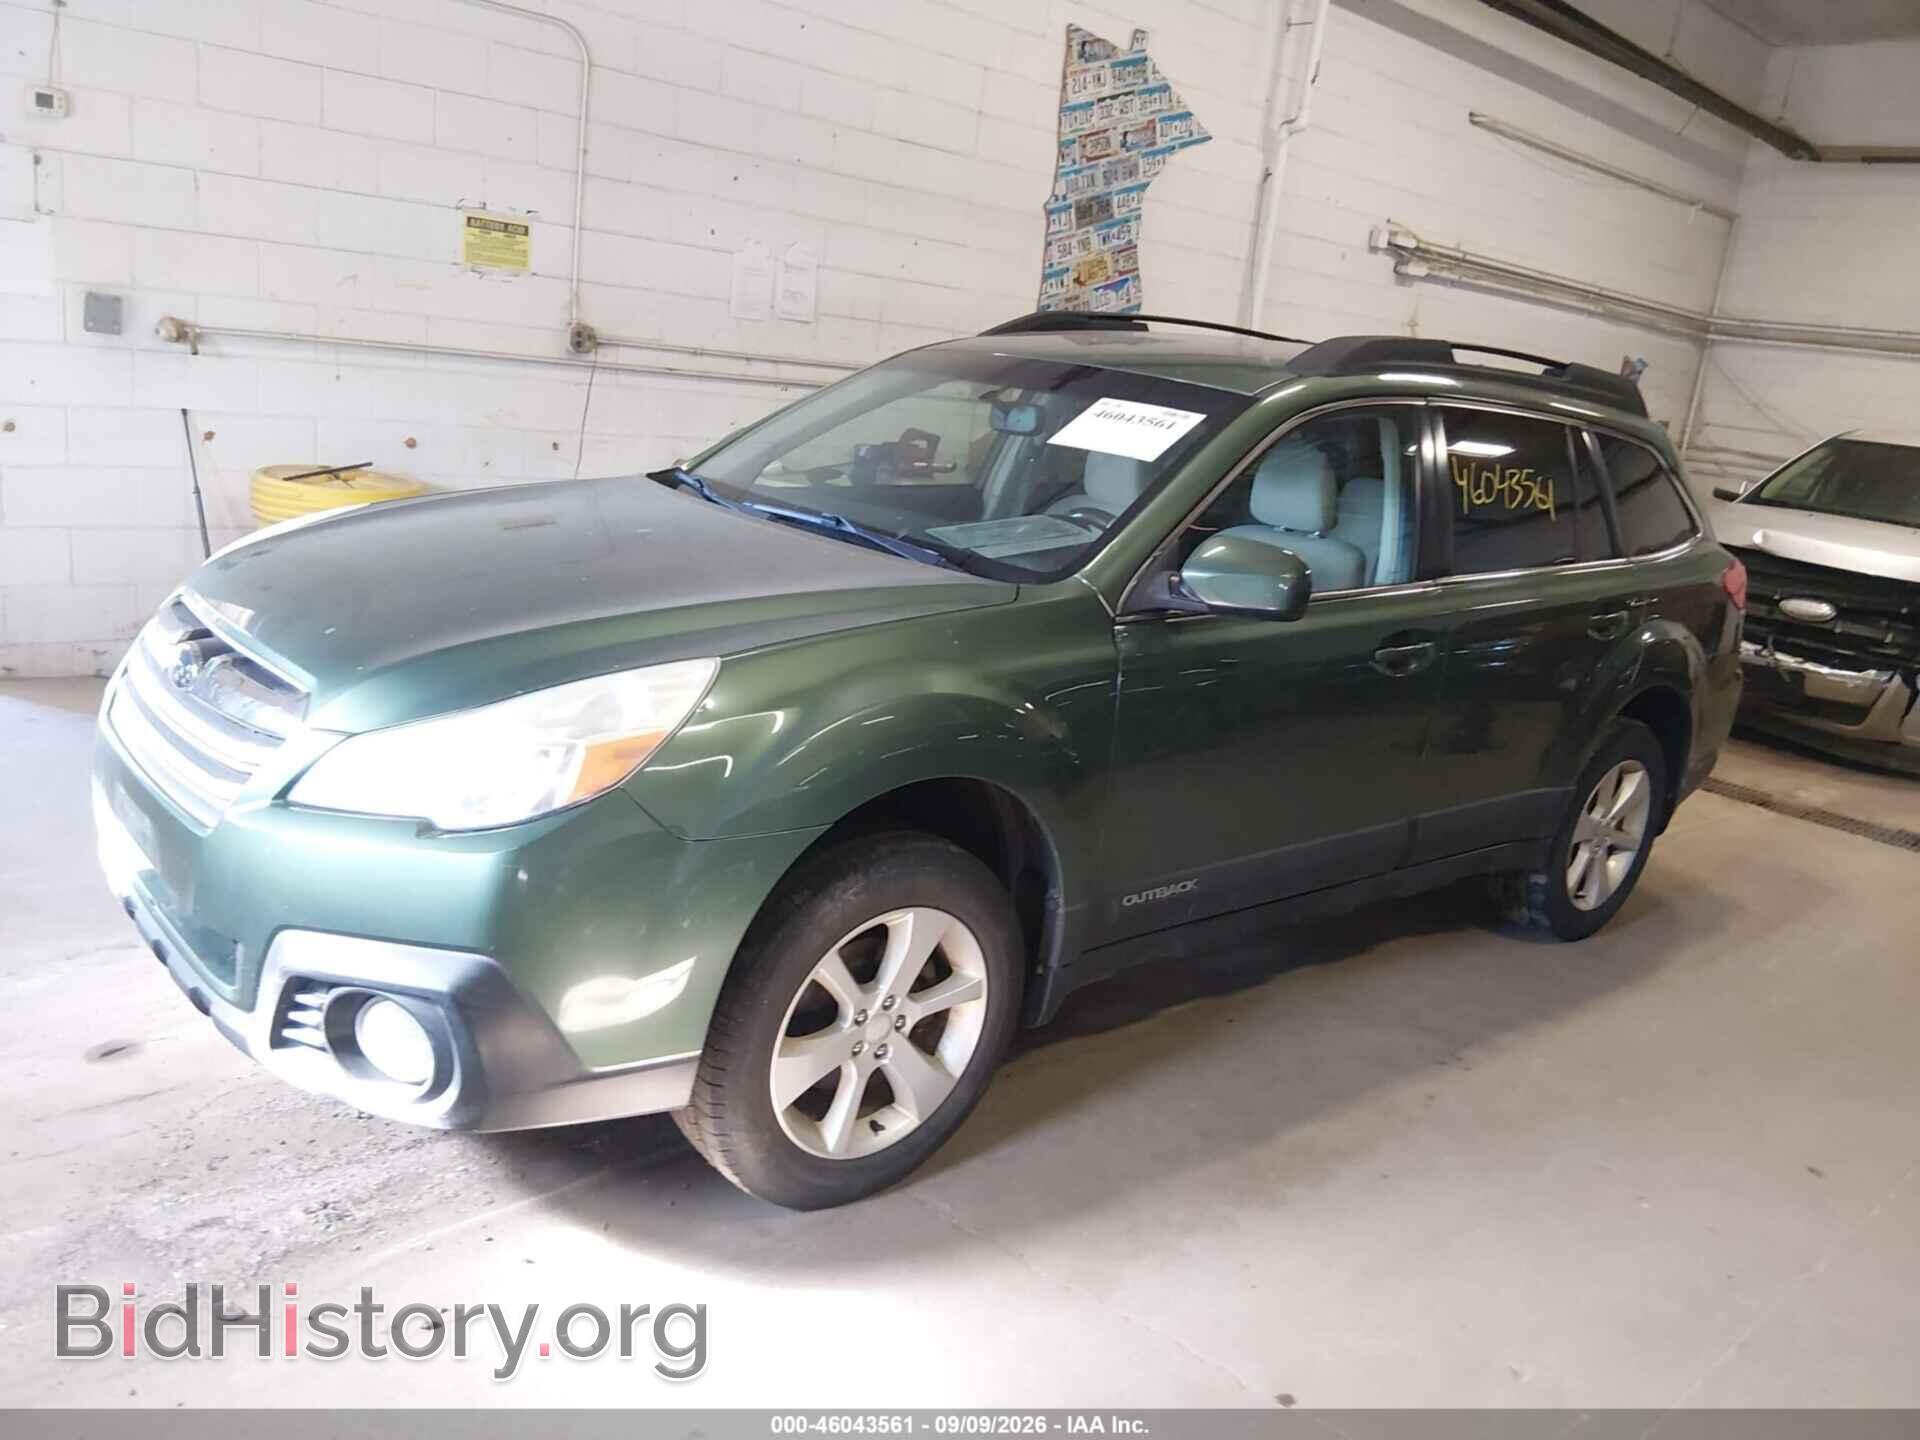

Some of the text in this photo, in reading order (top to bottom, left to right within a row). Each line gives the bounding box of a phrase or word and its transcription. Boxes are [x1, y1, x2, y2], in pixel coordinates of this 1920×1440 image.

[1094, 409, 1177, 430] 46043561
[1451, 455, 1557, 522] 46043561
[1122, 878, 1199, 907] OUTBACK
